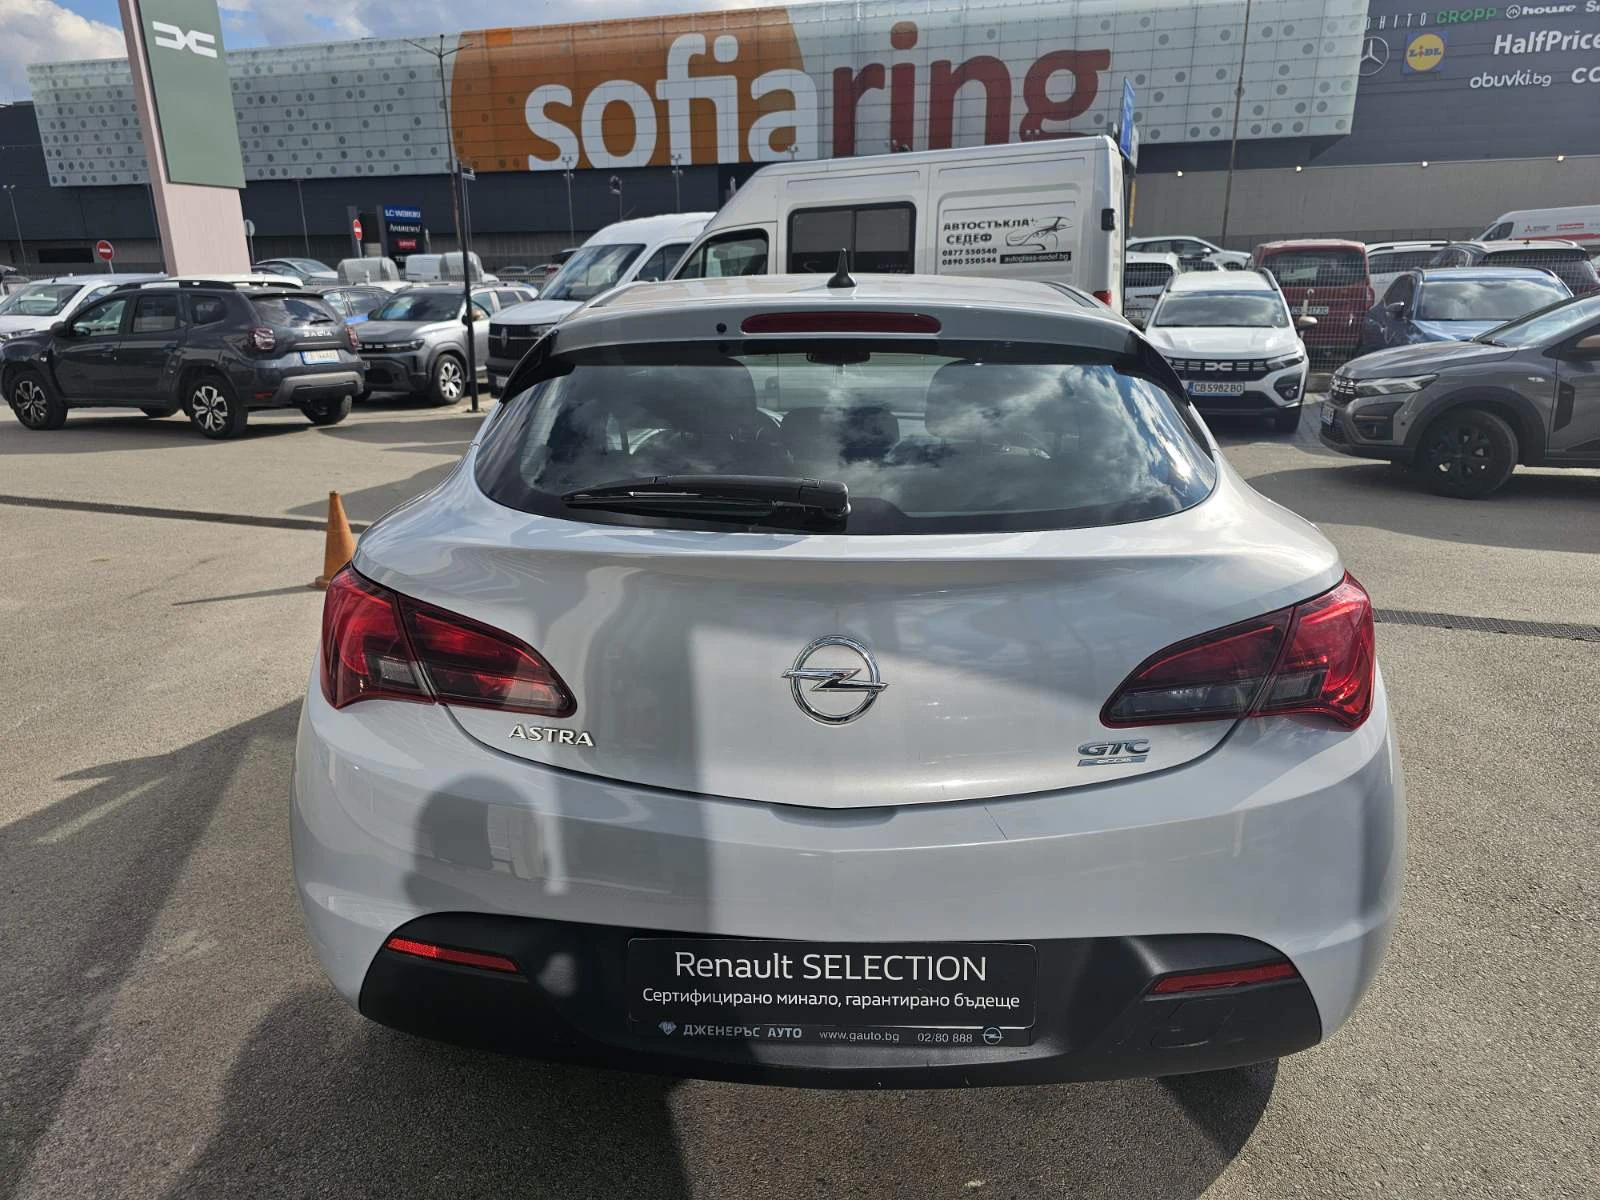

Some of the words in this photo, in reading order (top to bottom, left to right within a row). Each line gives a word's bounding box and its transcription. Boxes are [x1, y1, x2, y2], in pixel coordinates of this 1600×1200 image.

[1436, 7, 1497, 24] CROPP
[1494, 30, 1600, 55] HalfPrice
[1470, 69, 1551, 89] obuvki.bg
[946, 233, 992, 246] СЕДЕФ
[508, 723, 595, 747] ASTRA
[1078, 739, 1151, 756] GTC
[675, 951, 793, 979] Renault
[802, 953, 987, 981] SELECTION
[642, 987, 773, 1006] Сертифицирано
[777, 992, 841, 1008] минало,
[845, 994, 950, 1009] гарантирано
[954, 992, 1020, 1009] бъдеще
[683, 1024, 760, 1037] ДЖЕНЕРЪС
[767, 1026, 802, 1039] АУТО
[819, 1030, 900, 1043] www.gauto.bg
[917, 1032, 949, 1043] 02/80
[952, 1033, 973, 1043] 888
